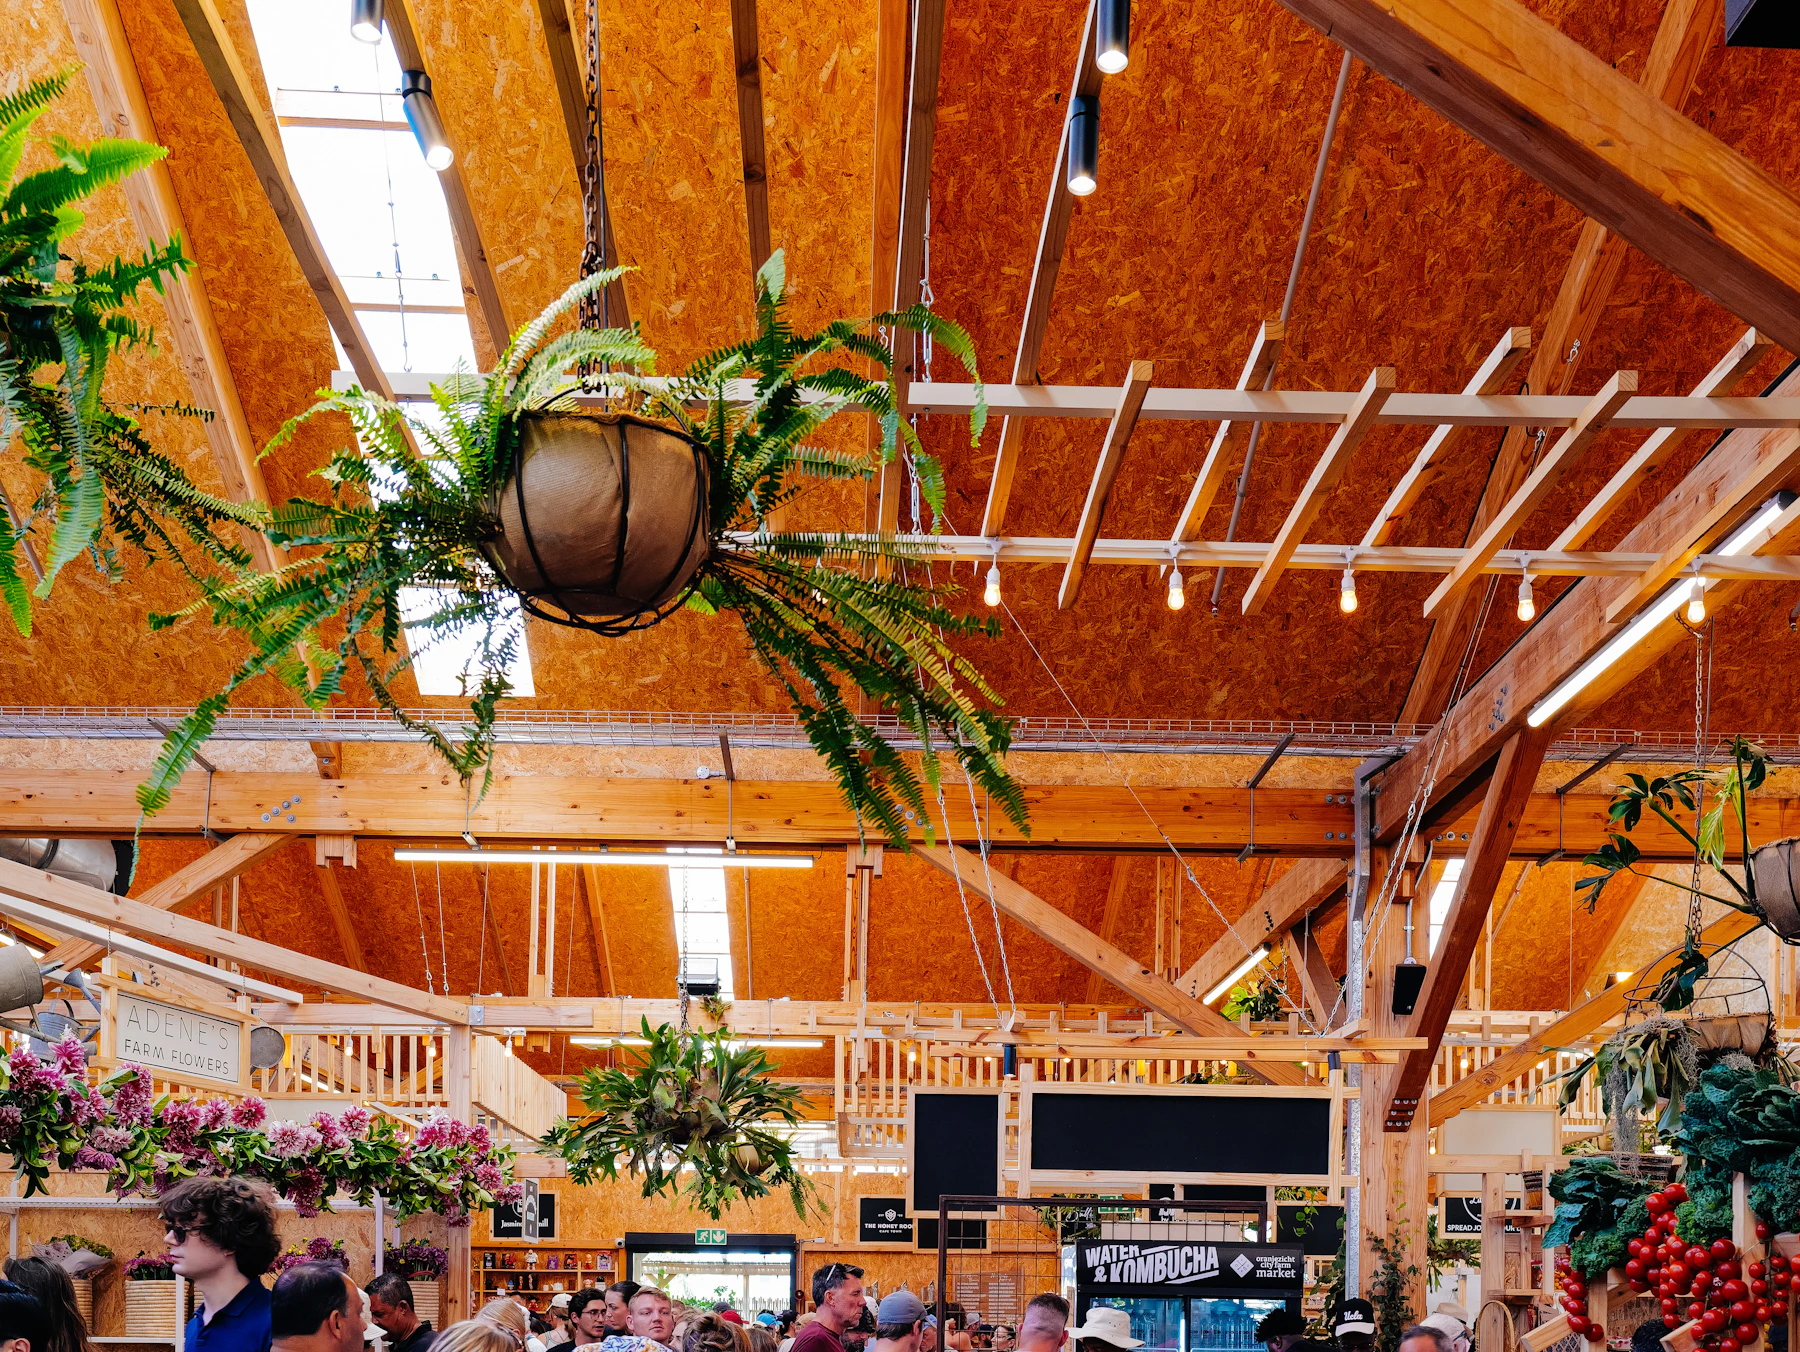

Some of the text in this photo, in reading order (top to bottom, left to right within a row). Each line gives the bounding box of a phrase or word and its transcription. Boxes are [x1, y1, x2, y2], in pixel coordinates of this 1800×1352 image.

[127, 1005, 229, 1050] ADENE'S
[125, 1038, 229, 1075] FARM FLOWERS
[1446, 1223, 1473, 1232] SPREAD
[1473, 1224, 1482, 1232] JO
[1085, 1244, 1140, 1268] WATER
[1093, 1265, 1108, 1282] &
[1109, 1245, 1220, 1283] KOMBUCHA
[1255, 1255, 1296, 1263] oranjezicht
[1260, 1260, 1292, 1269] city farm
[1255, 1267, 1296, 1278] market
